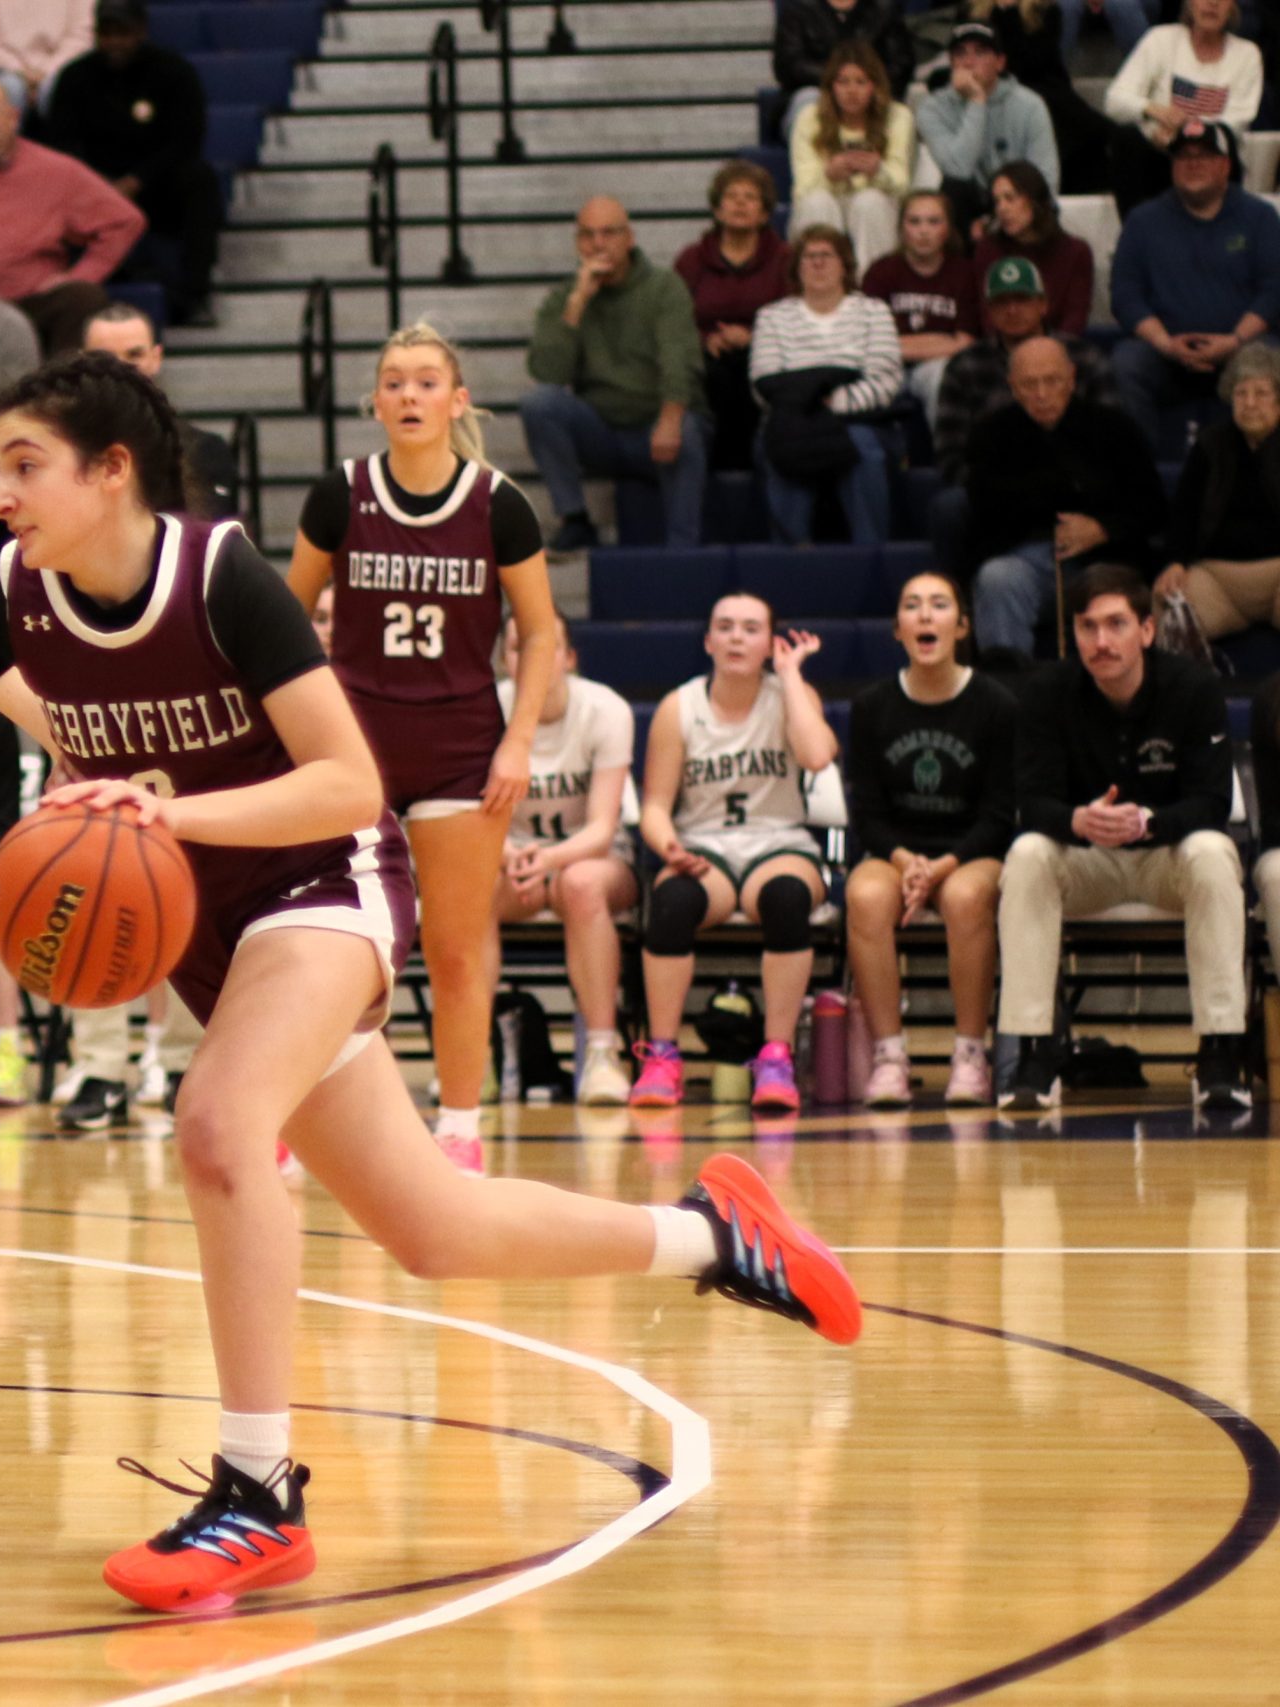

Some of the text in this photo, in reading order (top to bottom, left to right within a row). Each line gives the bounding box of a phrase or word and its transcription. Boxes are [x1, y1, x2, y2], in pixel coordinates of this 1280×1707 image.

[348, 552, 487, 595] DERRYFIELD
[383, 602, 445, 659] 23
[45, 687, 252, 758] ERRYFIELD
[685, 749, 787, 786] SPARTANS
[528, 813, 568, 840] 11
[724, 792, 749, 826] 5
